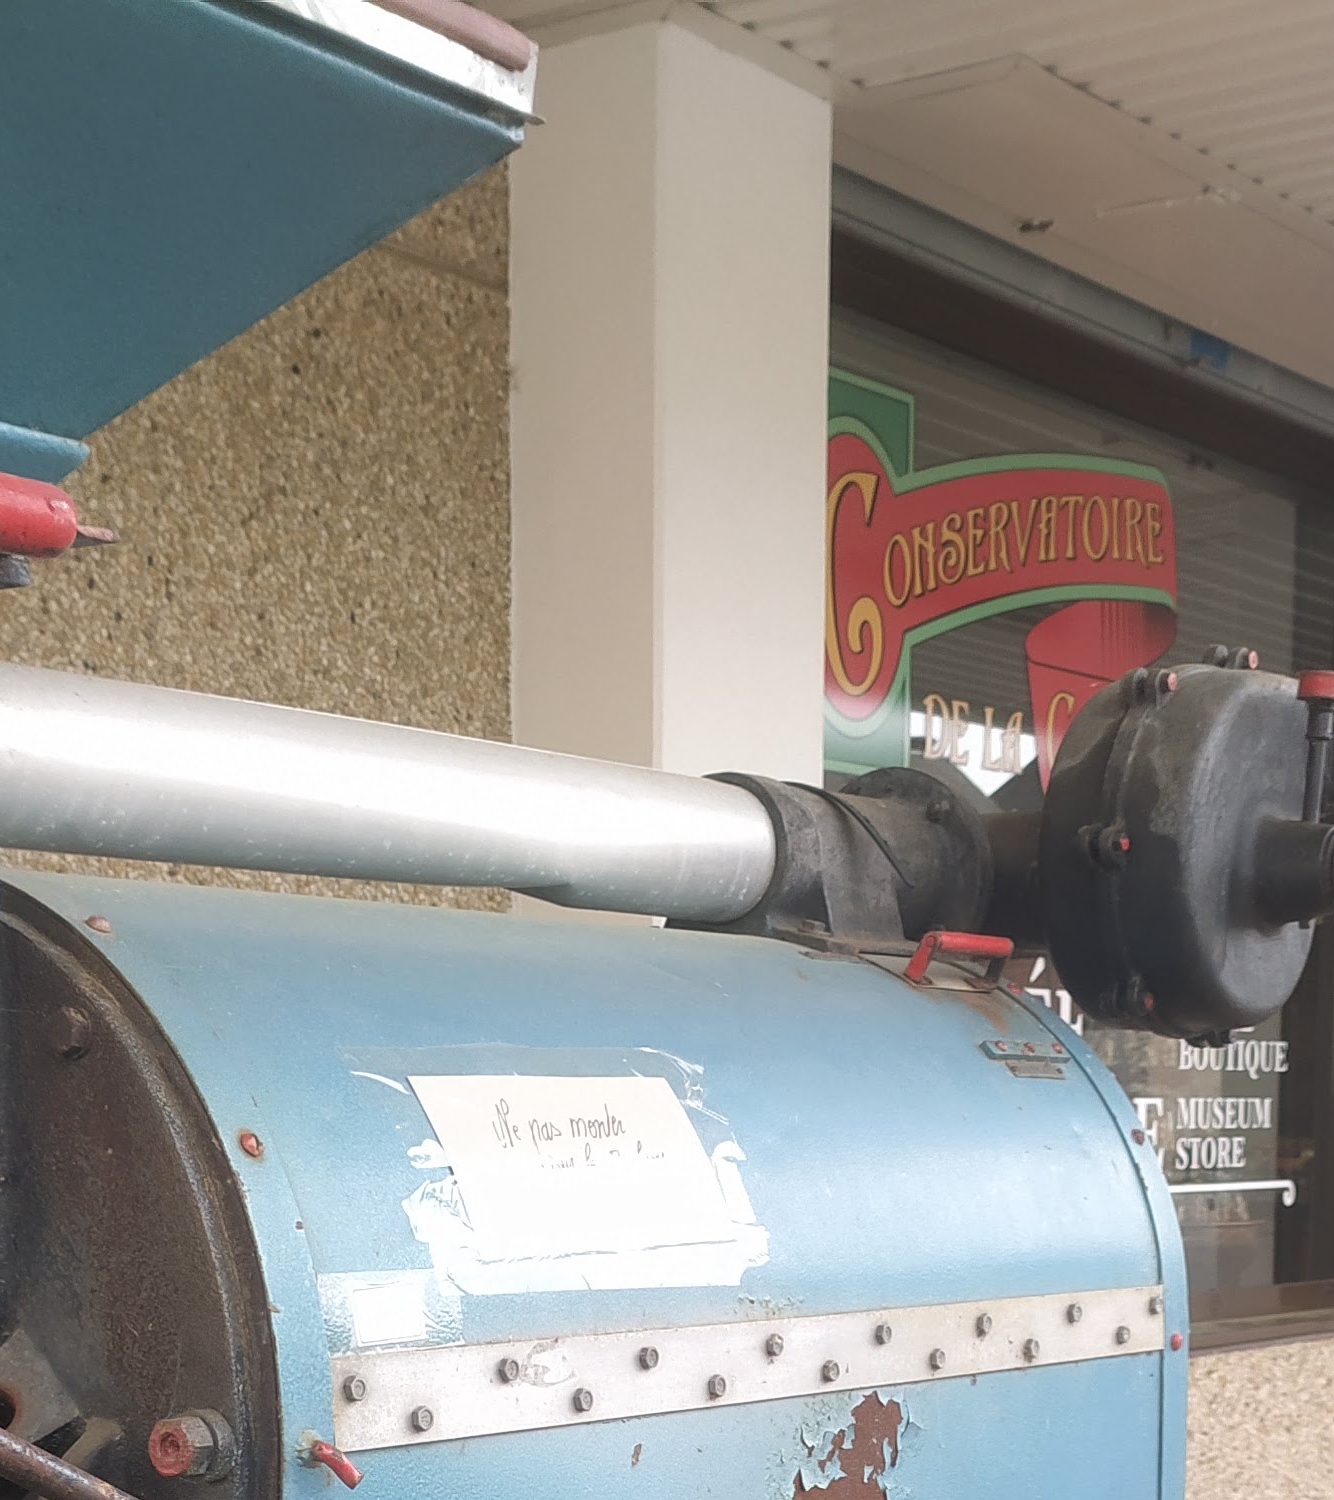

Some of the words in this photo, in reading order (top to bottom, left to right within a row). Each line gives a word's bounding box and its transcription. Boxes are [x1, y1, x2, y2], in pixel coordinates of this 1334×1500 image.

[923, 693, 970, 766] DE
[981, 705, 1025, 775] LA
[1178, 1039, 1290, 1080] BOUTIQUE
[528, 1118, 562, 1155] pas
[569, 1103, 627, 1139] monter
[1175, 1097, 1273, 1130] MUSEUM
[1175, 1136, 1247, 1170] STORE
